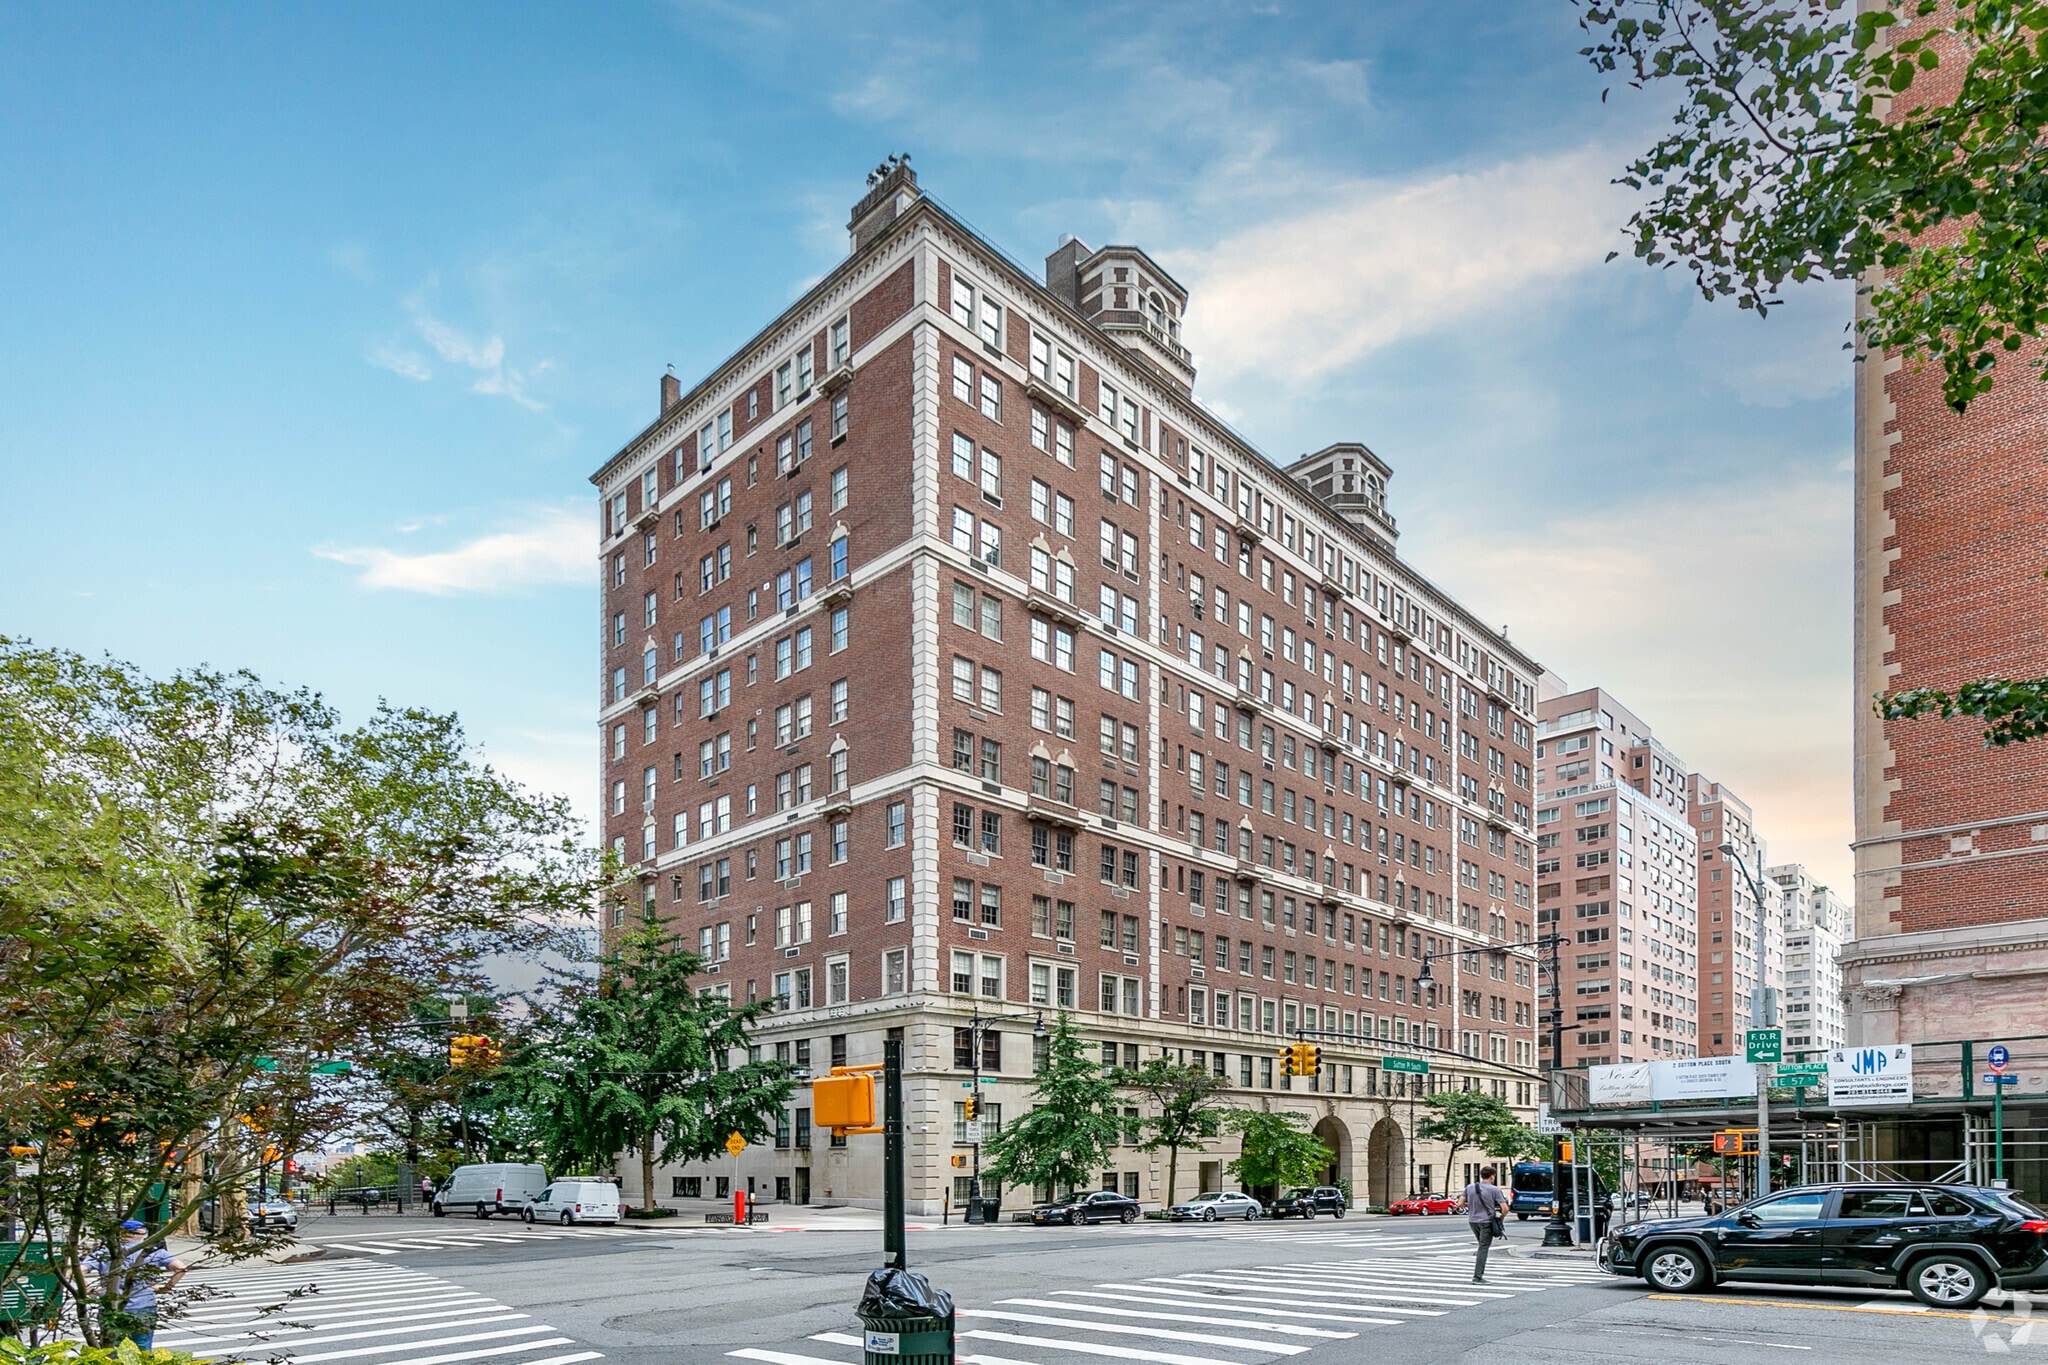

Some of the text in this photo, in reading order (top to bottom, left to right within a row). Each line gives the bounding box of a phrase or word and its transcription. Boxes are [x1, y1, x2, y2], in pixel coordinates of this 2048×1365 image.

[1851, 1049, 1887, 1075] JMA
[1629, 1069, 1640, 1078] 2
[1780, 1078, 1785, 1086] E
[1791, 1077, 1804, 1086] 57
[1733, 1136, 1738, 1149] 3
